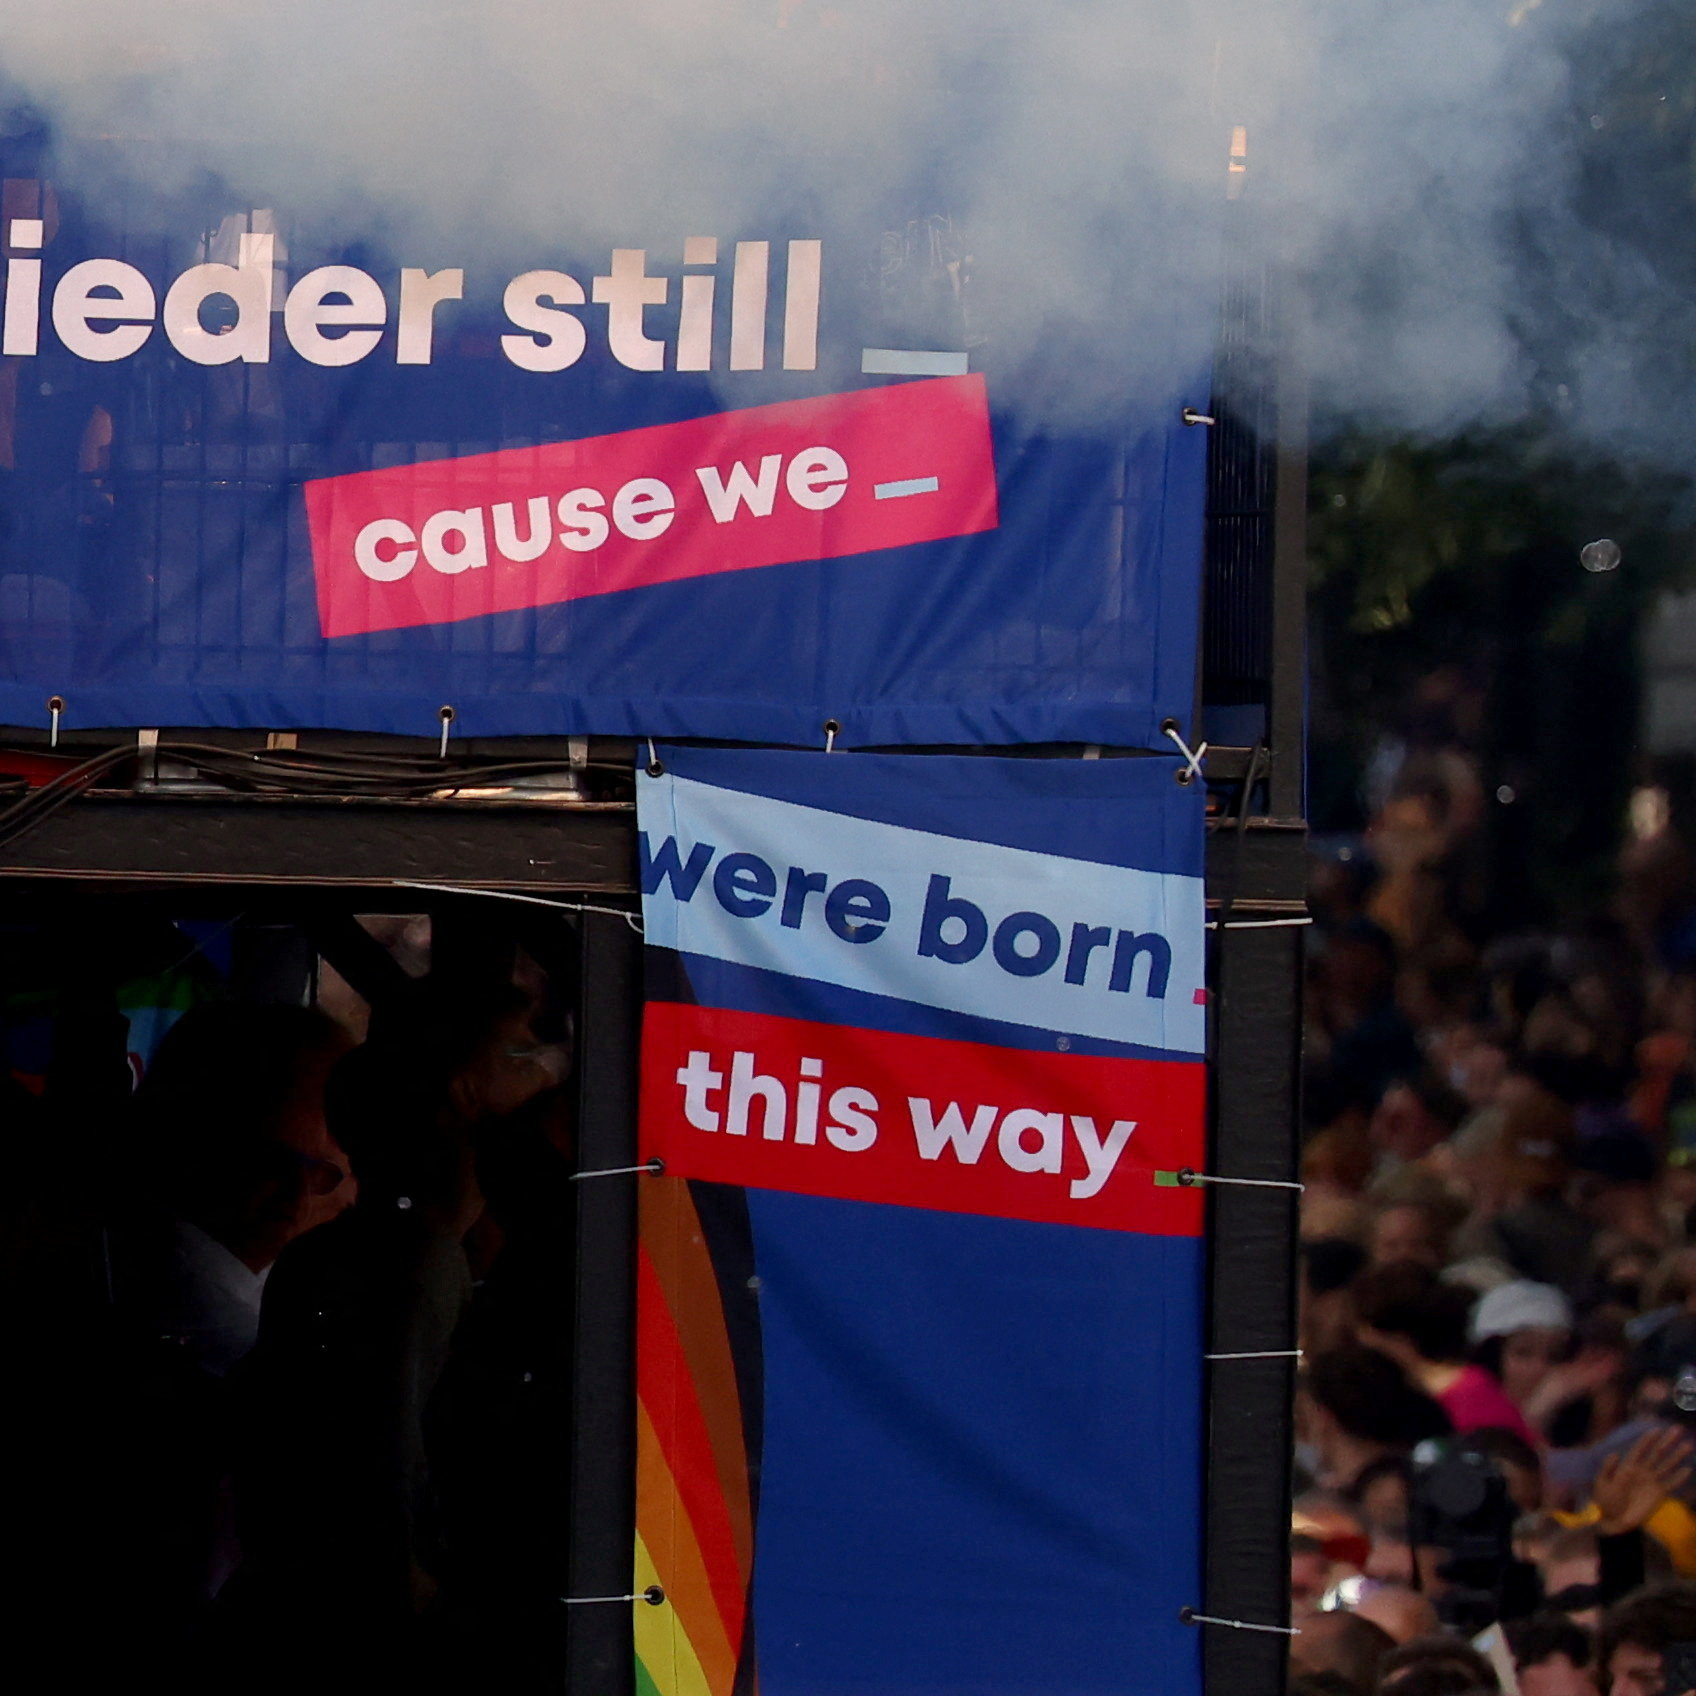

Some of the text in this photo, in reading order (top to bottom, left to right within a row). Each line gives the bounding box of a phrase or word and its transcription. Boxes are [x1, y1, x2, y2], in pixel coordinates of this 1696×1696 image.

[500, 235, 822, 372] still
[354, 446, 850, 583] cause we
[640, 829, 1173, 1001] were born
[676, 1051, 1138, 1199] this way
